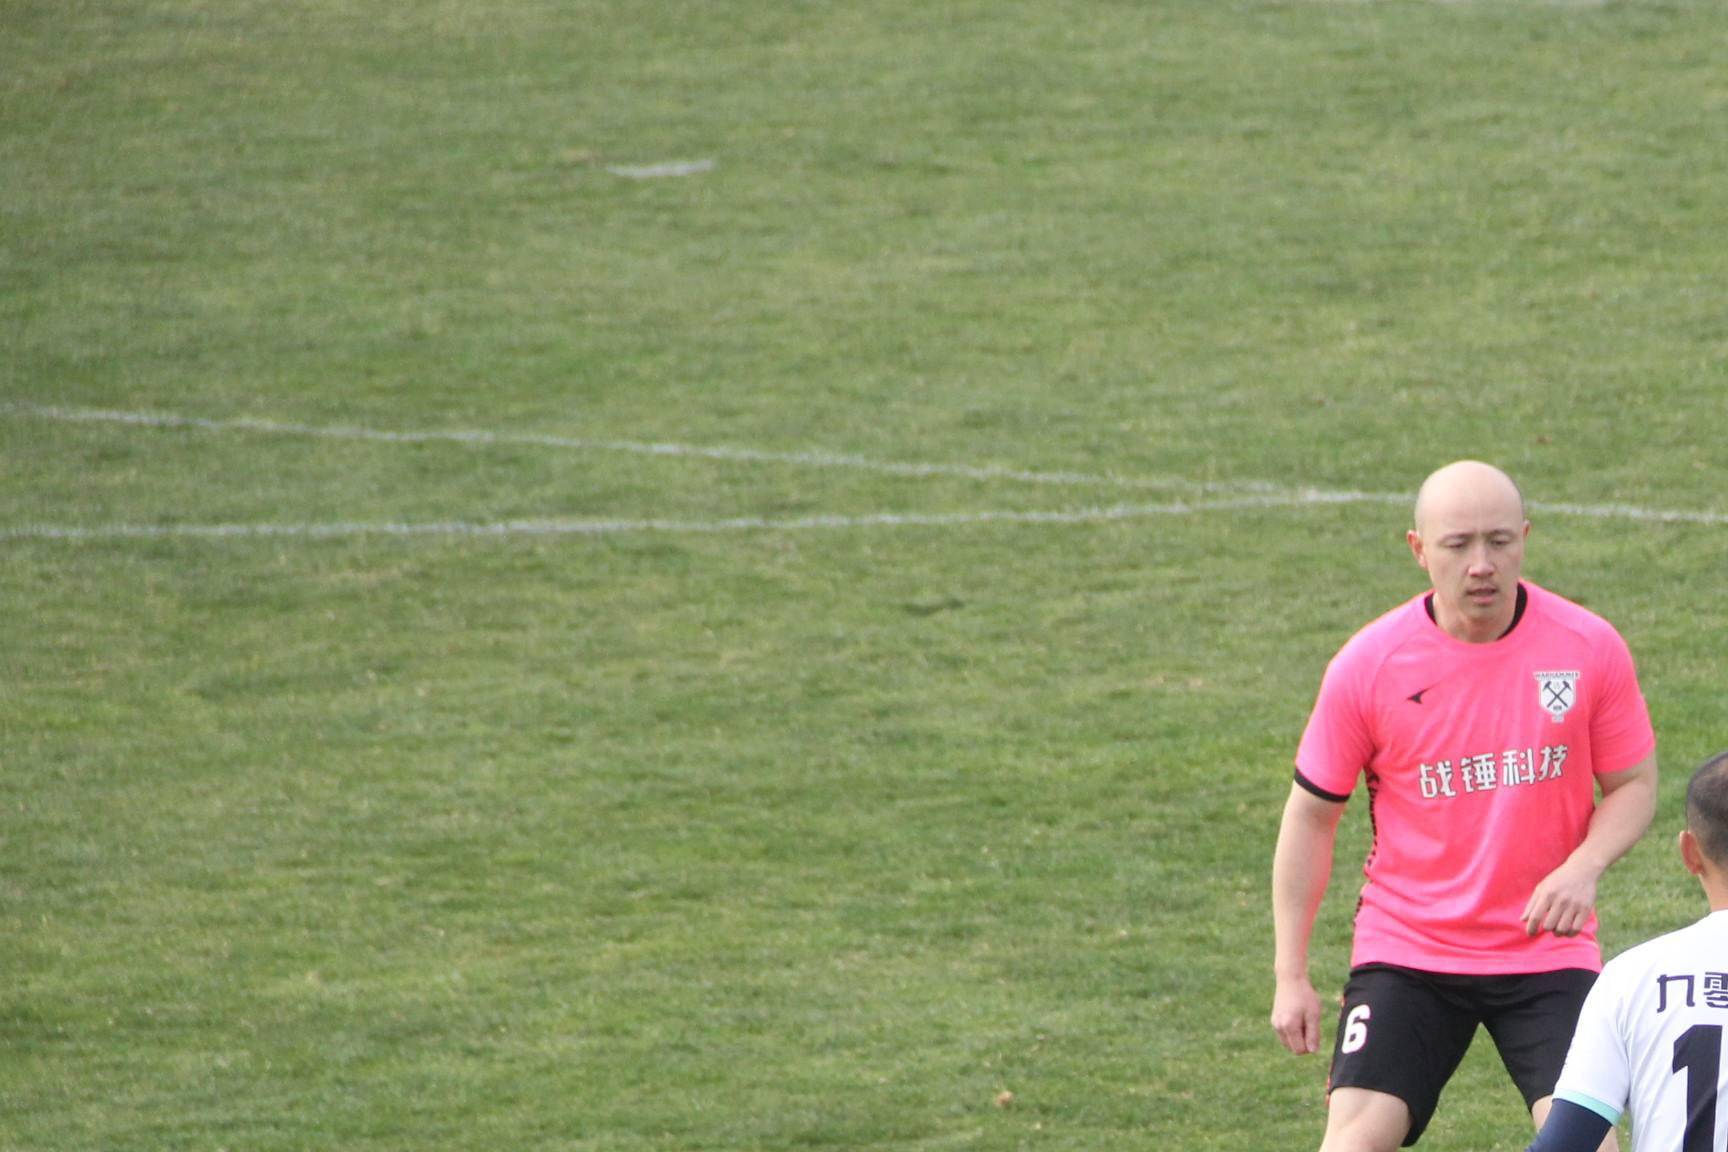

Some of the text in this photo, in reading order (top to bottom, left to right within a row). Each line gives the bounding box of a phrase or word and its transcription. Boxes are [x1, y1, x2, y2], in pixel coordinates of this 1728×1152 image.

[1418, 743, 1569, 798] 战锤科技
[1341, 1004, 1371, 1054] 6
